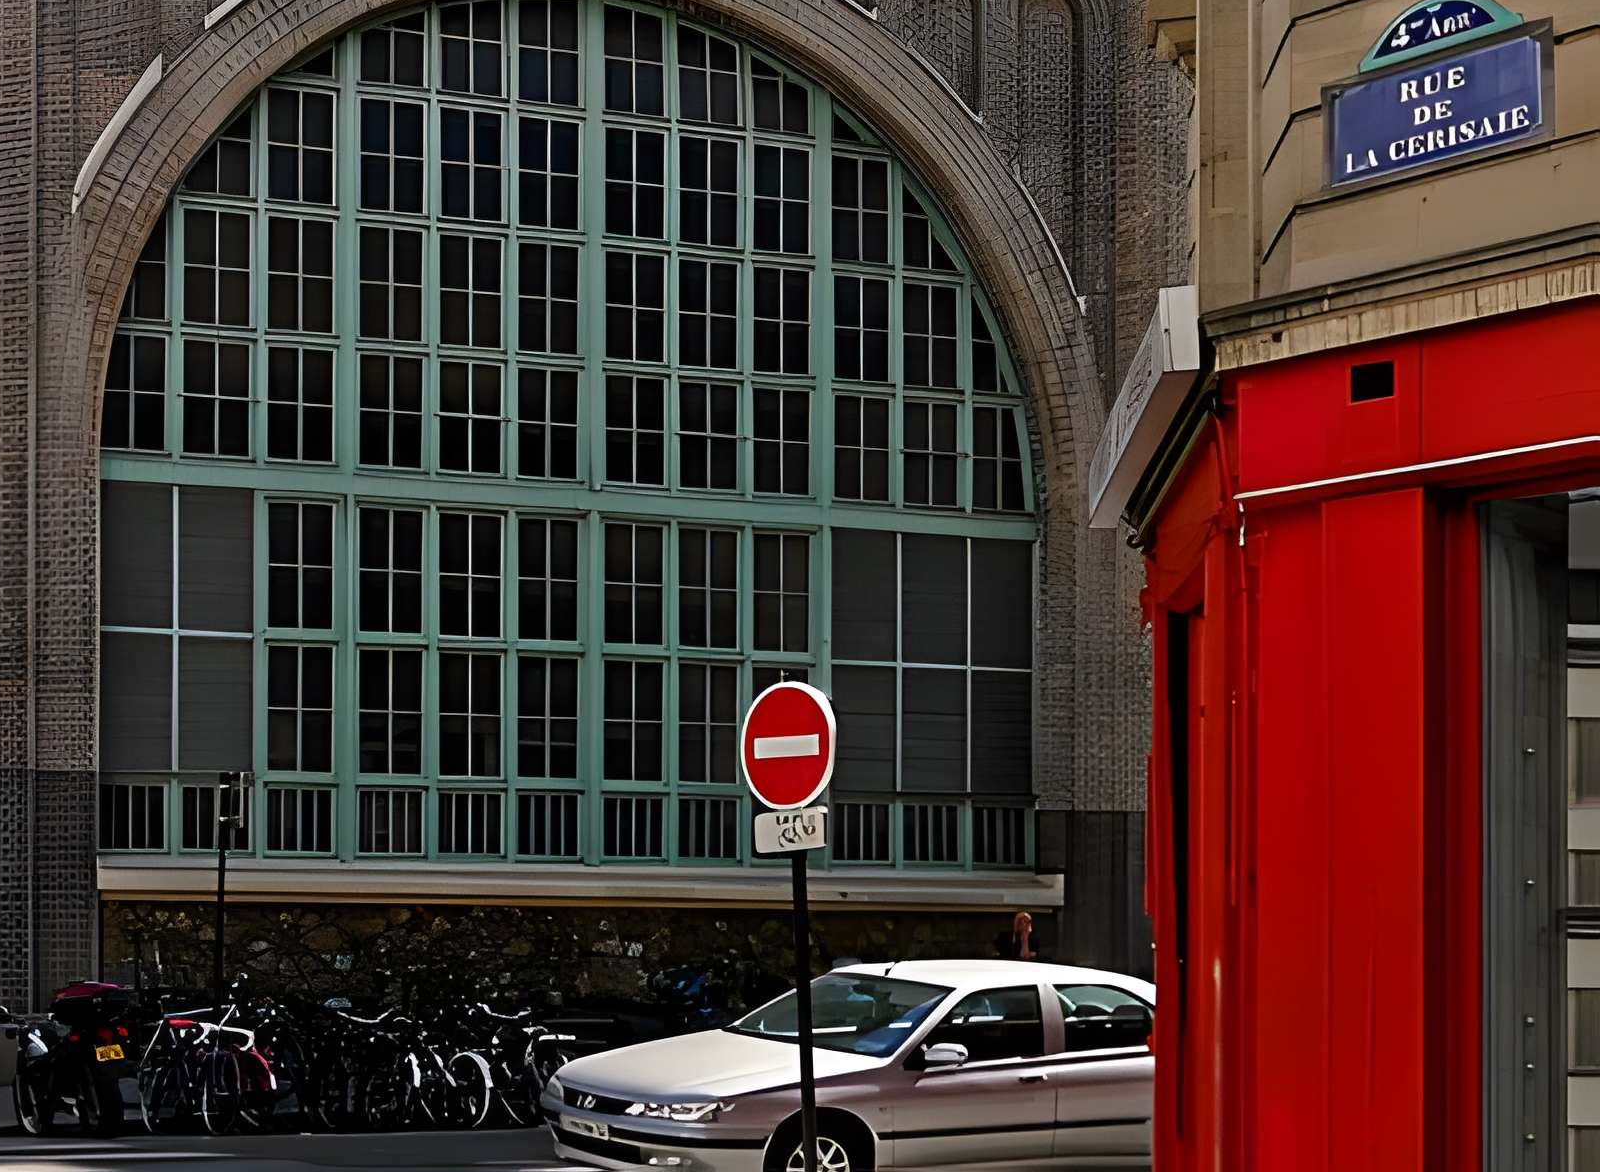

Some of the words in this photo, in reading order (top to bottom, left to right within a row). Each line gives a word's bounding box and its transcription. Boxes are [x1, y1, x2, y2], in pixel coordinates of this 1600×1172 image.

[1400, 66, 1466, 103] RUE
[1413, 99, 1453, 126] DE
[1345, 148, 1379, 173] LA
[1388, 104, 1530, 161] CERISAIE
